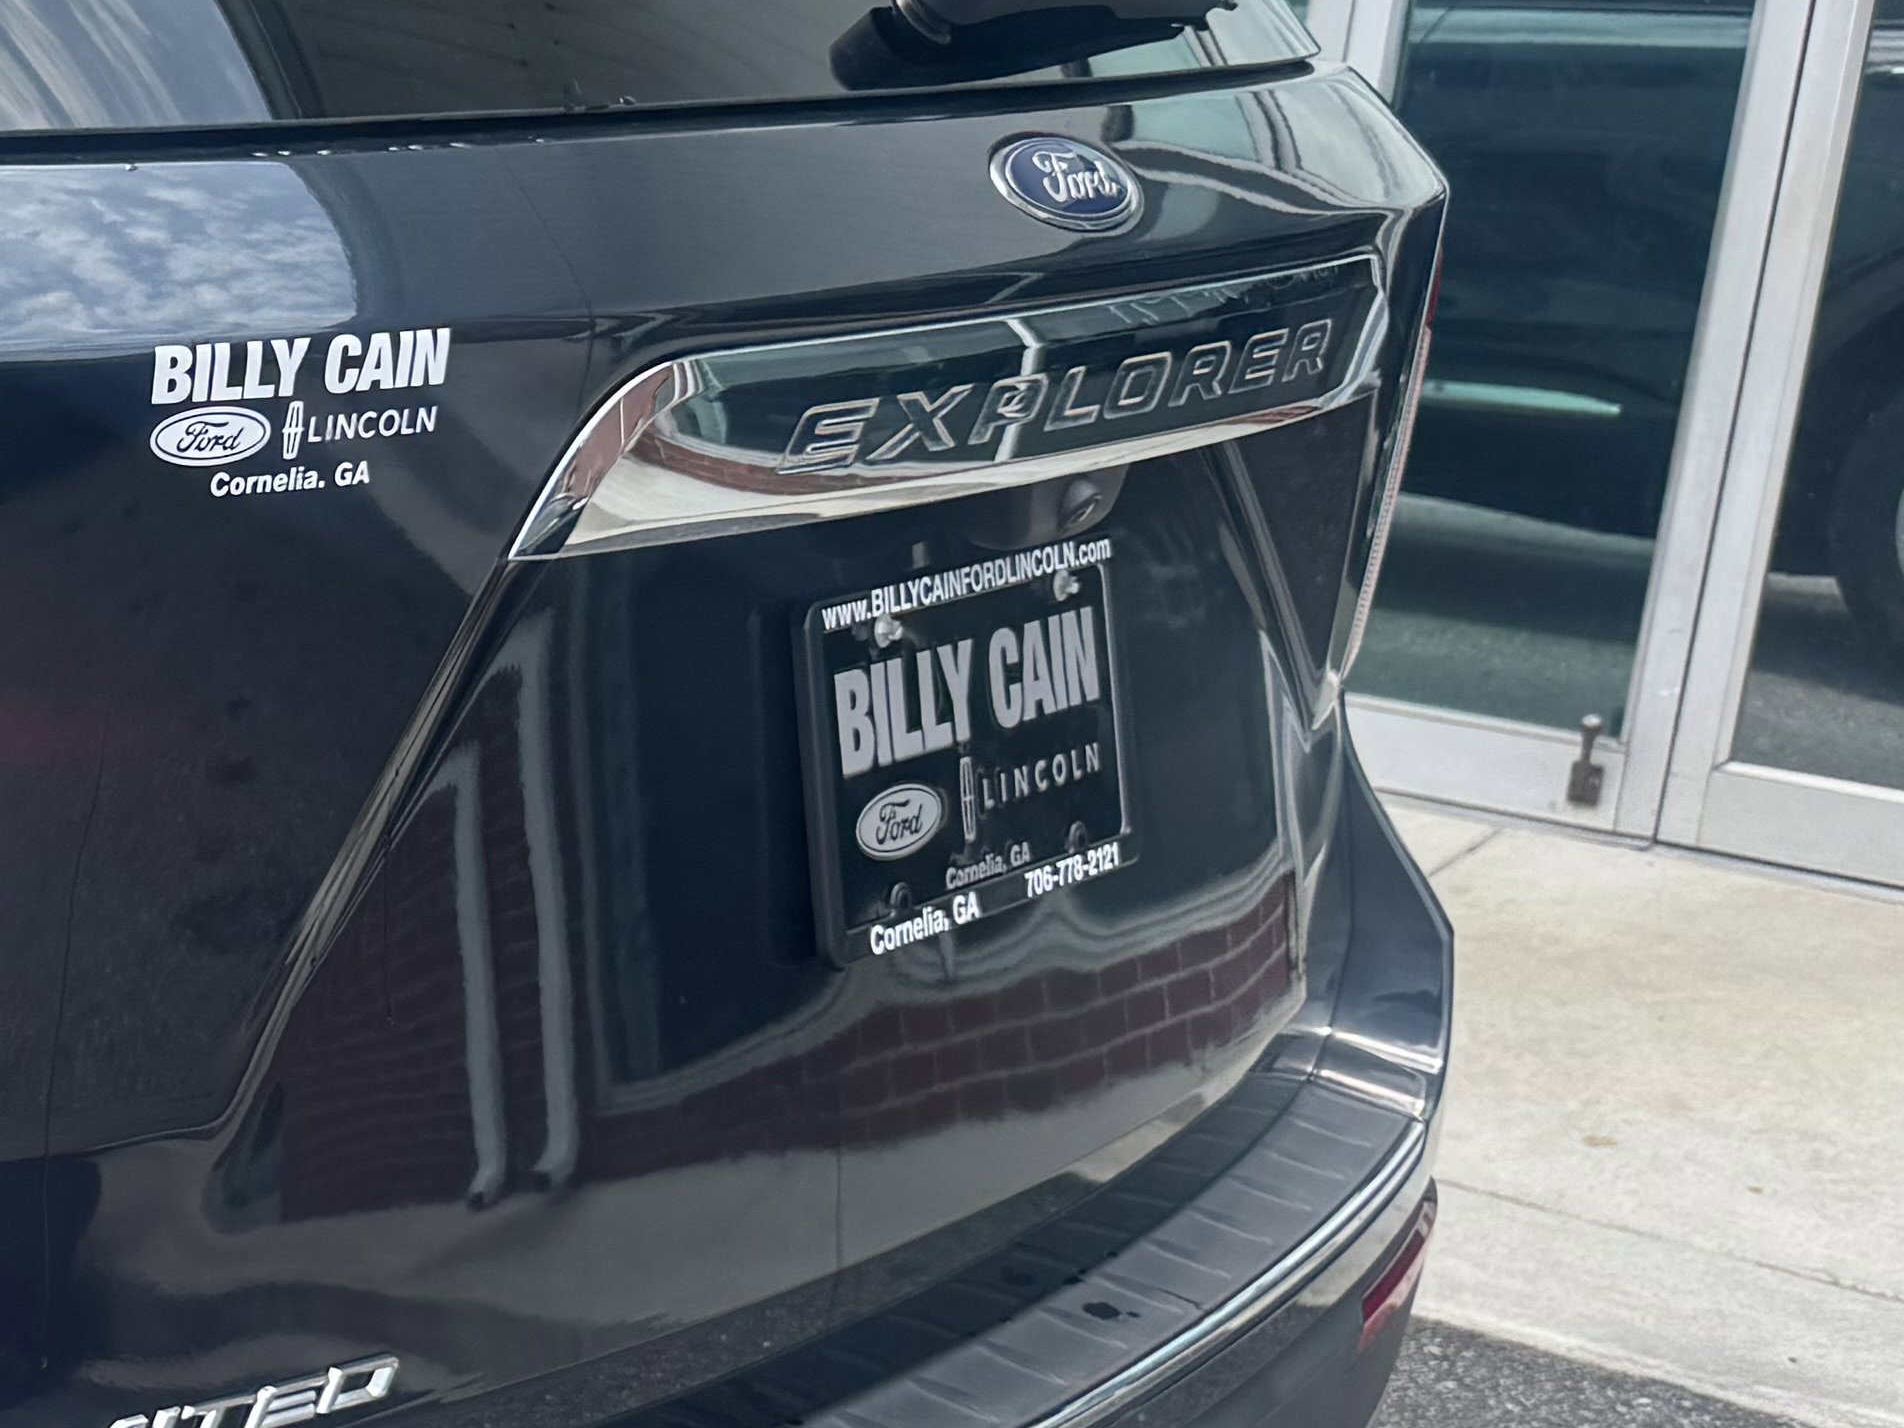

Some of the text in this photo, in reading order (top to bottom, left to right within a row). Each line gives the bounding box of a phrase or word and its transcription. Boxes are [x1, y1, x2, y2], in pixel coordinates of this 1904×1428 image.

[1032, 150, 1120, 203] Ford
[151, 327, 451, 405] BILLY CAIN
[777, 317, 1333, 474] EXPLORER
[176, 406, 439, 453] Ford LINCOLN
[334, 460, 370, 486] GA
[821, 538, 1112, 630] www.BILLYCAINFORDLINCOLN.com
[833, 605, 1101, 780] BILLY CAIN
[875, 742, 1101, 846] Ford LINCOLN
[952, 891, 982, 925] GA
[1023, 842, 1120, 898] 706-778-2121
[1010, 841, 1032, 867] GA
